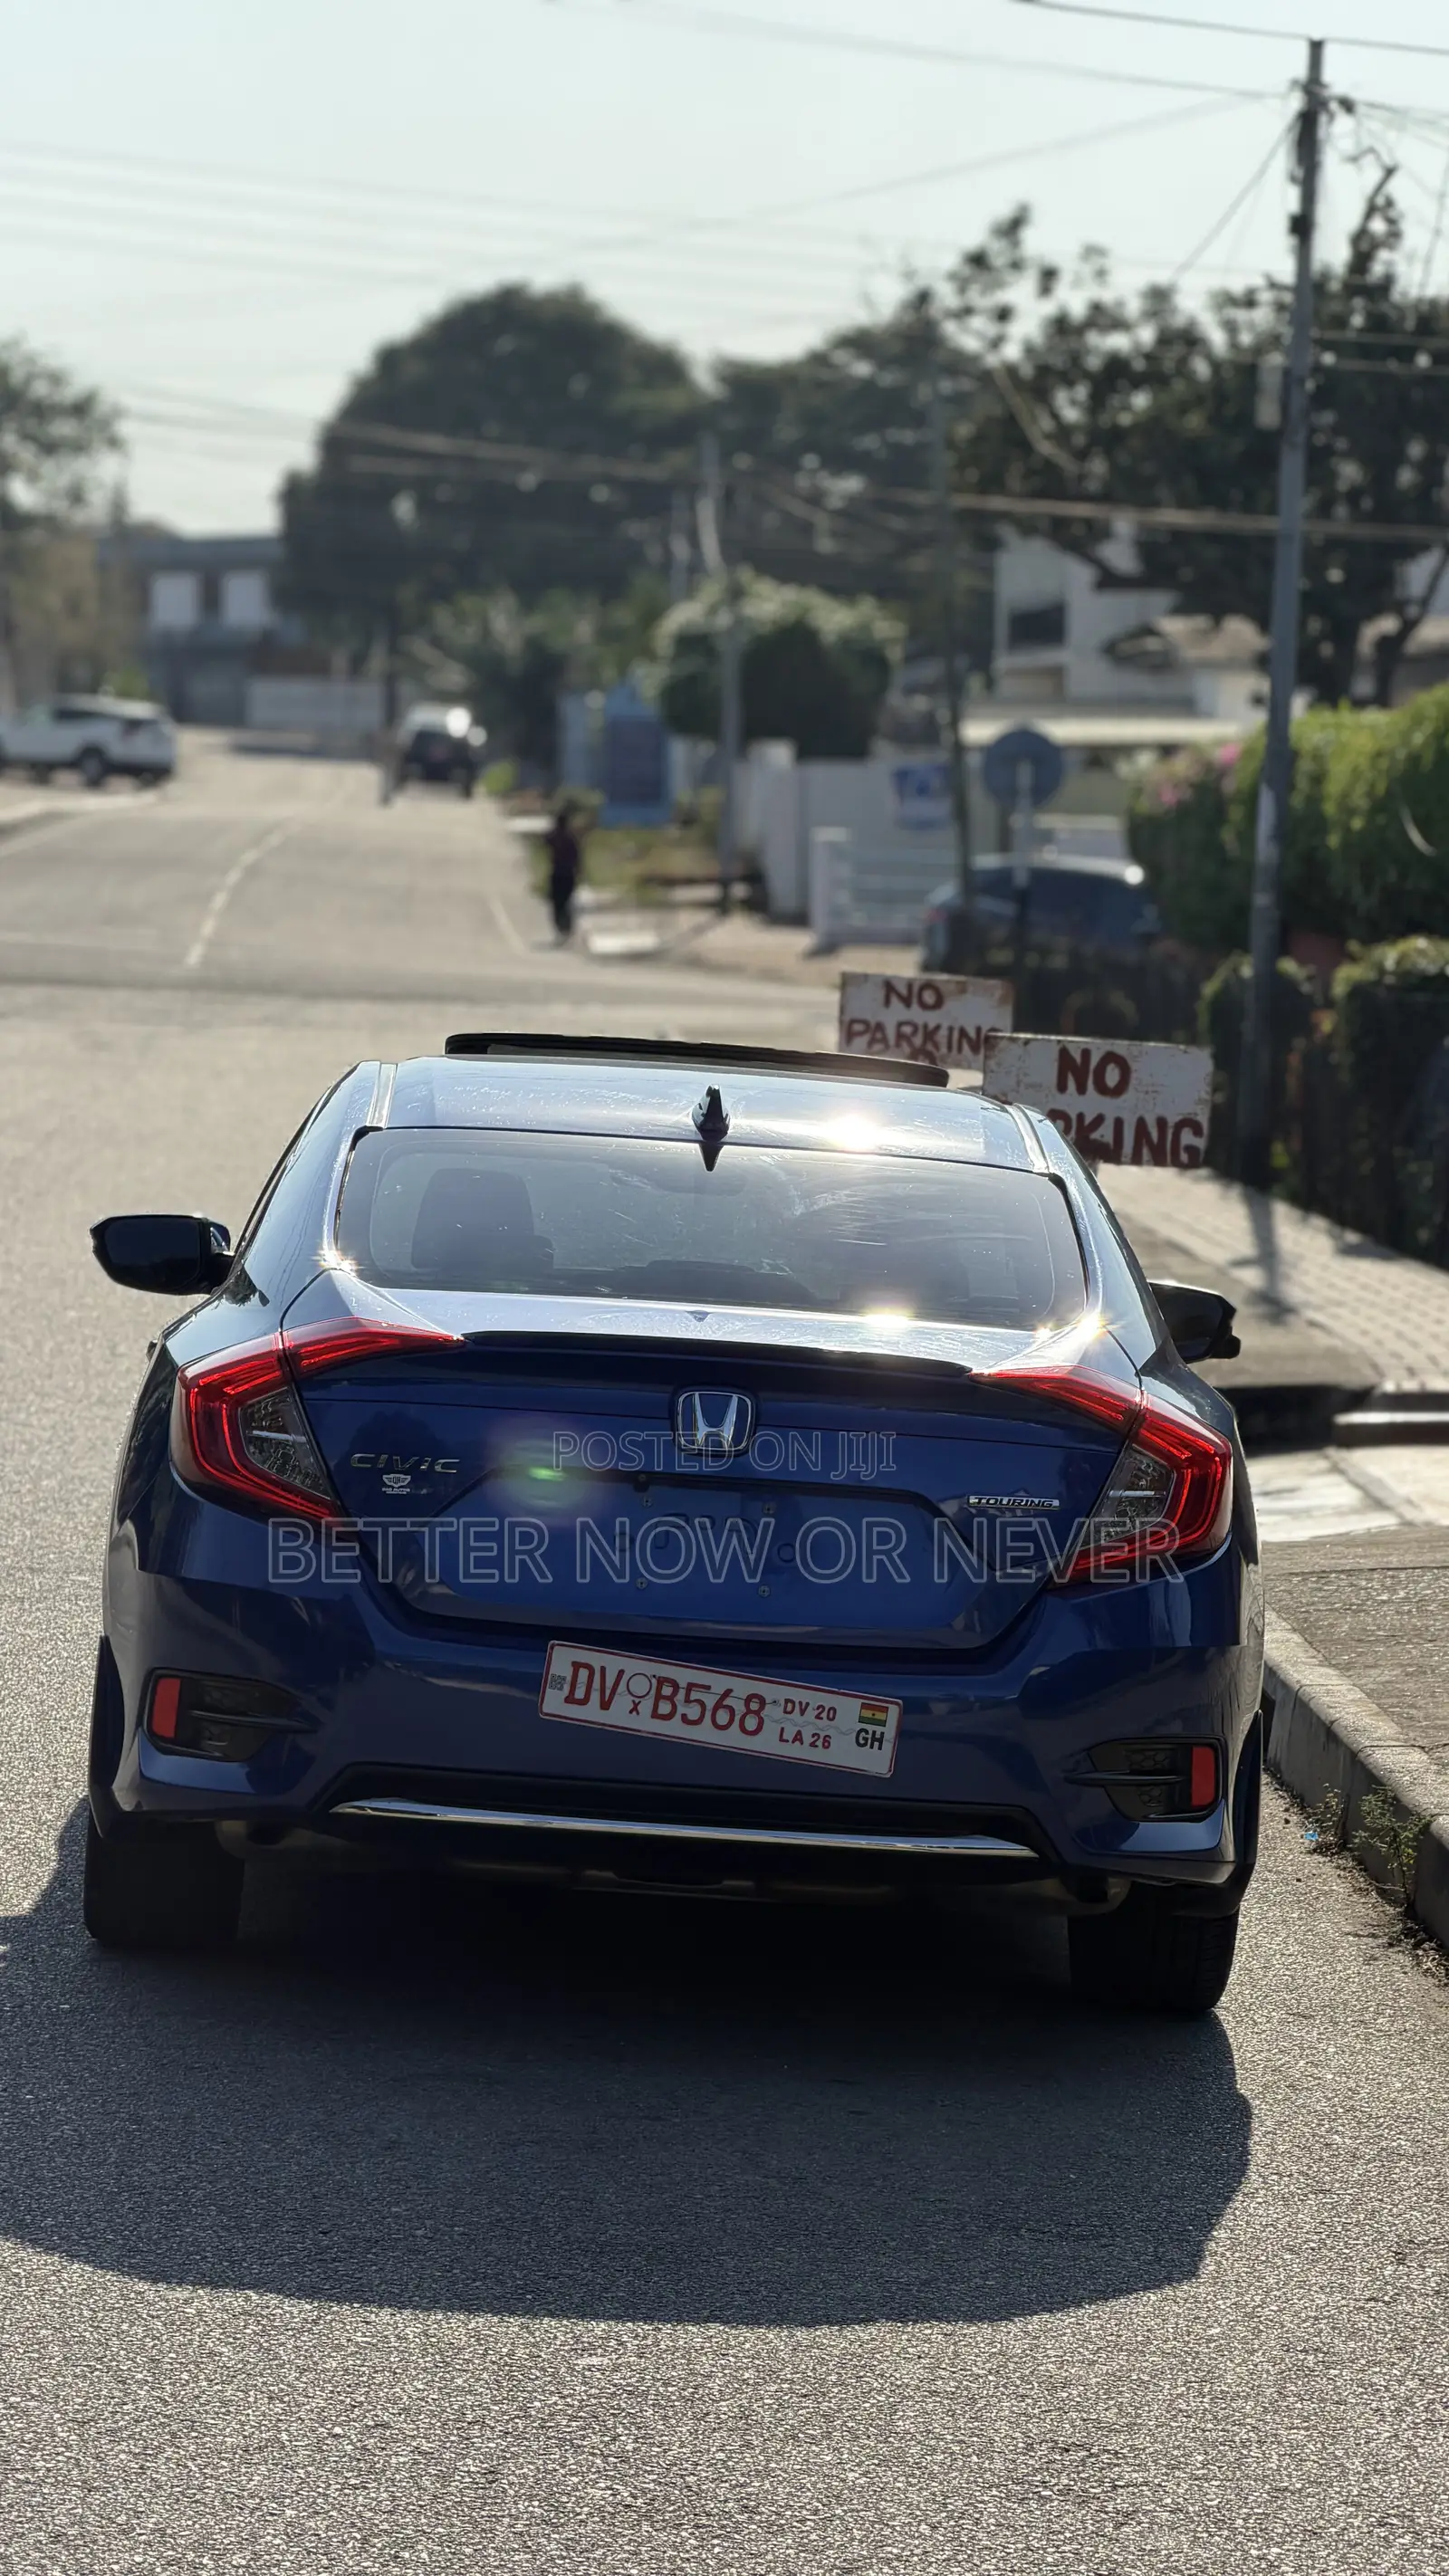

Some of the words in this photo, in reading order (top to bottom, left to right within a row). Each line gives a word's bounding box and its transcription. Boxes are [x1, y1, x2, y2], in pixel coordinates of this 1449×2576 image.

[882, 979, 945, 1011] NO
[845, 1017, 1004, 1056] PARKIN
[1056, 1044, 1132, 1099] NO
[350, 1454, 459, 1472] CIVIC
[974, 1497, 1054, 1508] TOURING
[564, 1661, 626, 1711] DV
[650, 1676, 766, 1737] B568
[782, 1698, 811, 1718] DV
[812, 1706, 837, 1722] 20
[778, 1726, 804, 1746] LA
[809, 1733, 831, 1750] 26
[854, 1728, 886, 1751] GH
